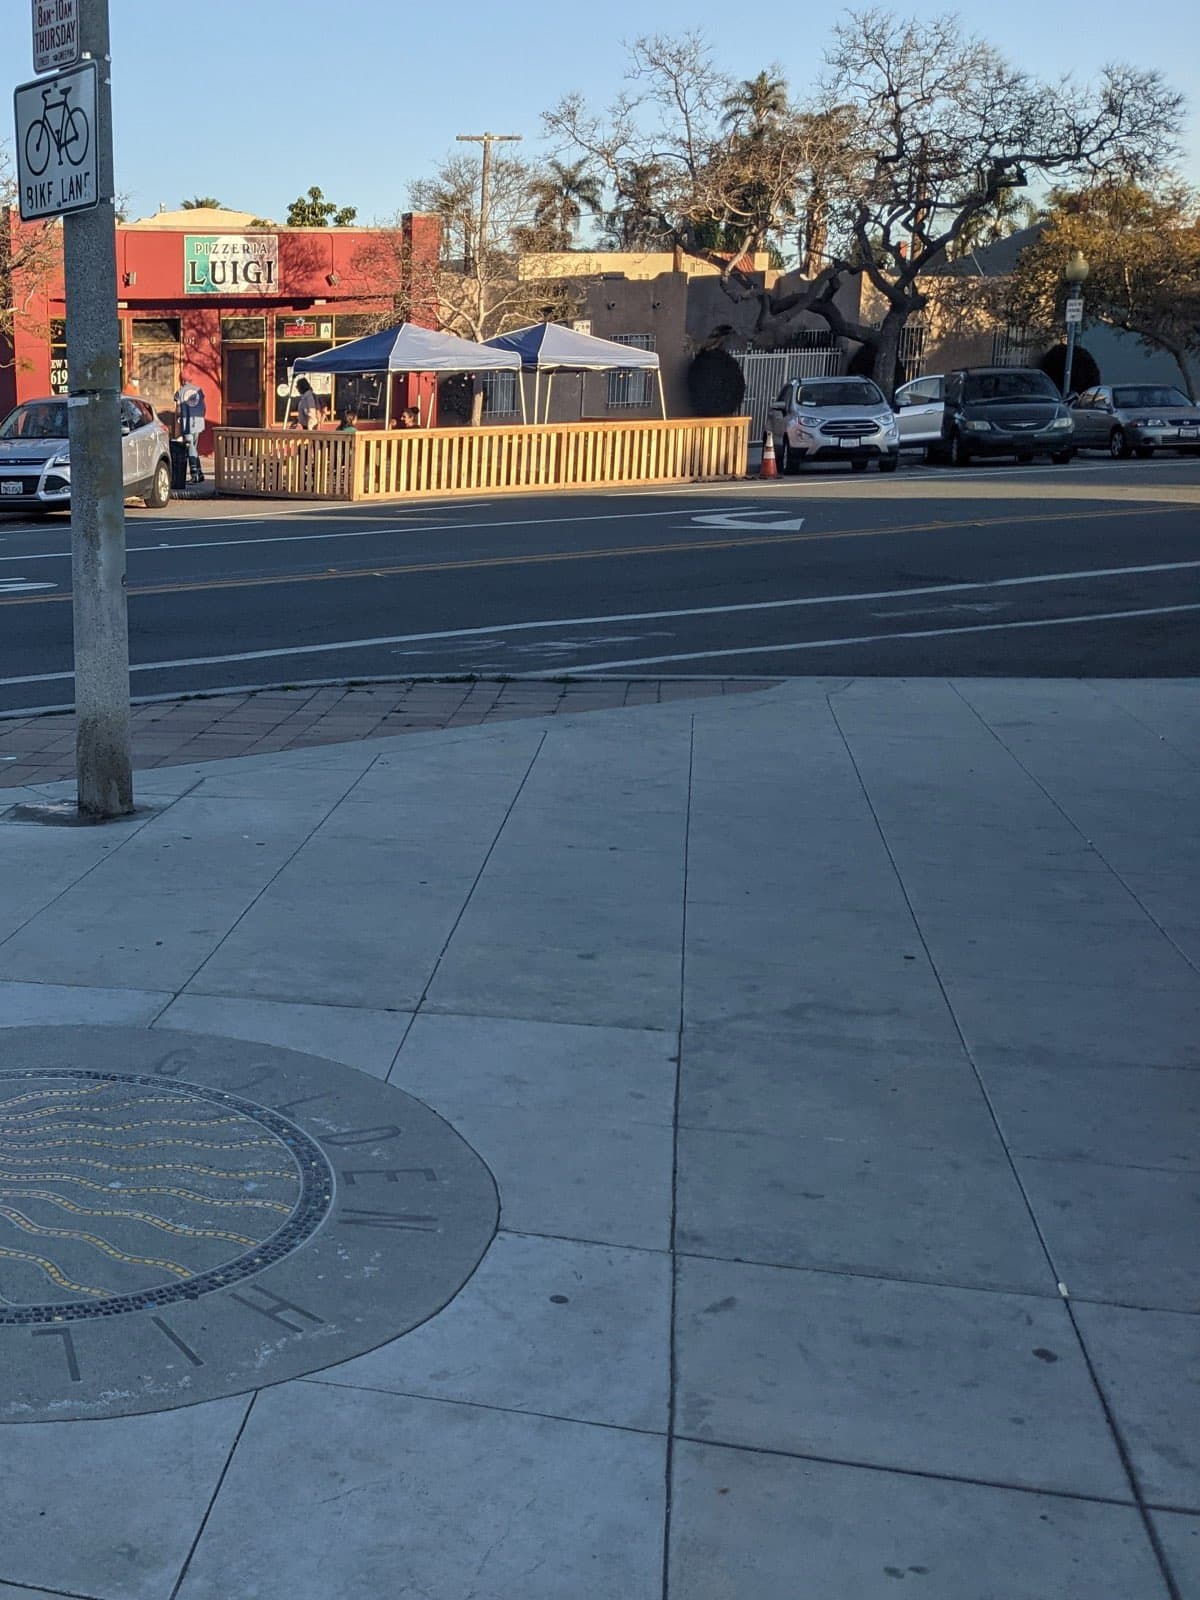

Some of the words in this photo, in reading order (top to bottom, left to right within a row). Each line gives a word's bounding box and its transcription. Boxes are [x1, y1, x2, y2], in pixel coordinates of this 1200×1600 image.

[35, 20, 76, 54] THURSDAY
[194, 242, 268, 255] PIZZERIA
[189, 260, 274, 286] LUIGI
[50, 370, 68, 385] 619
